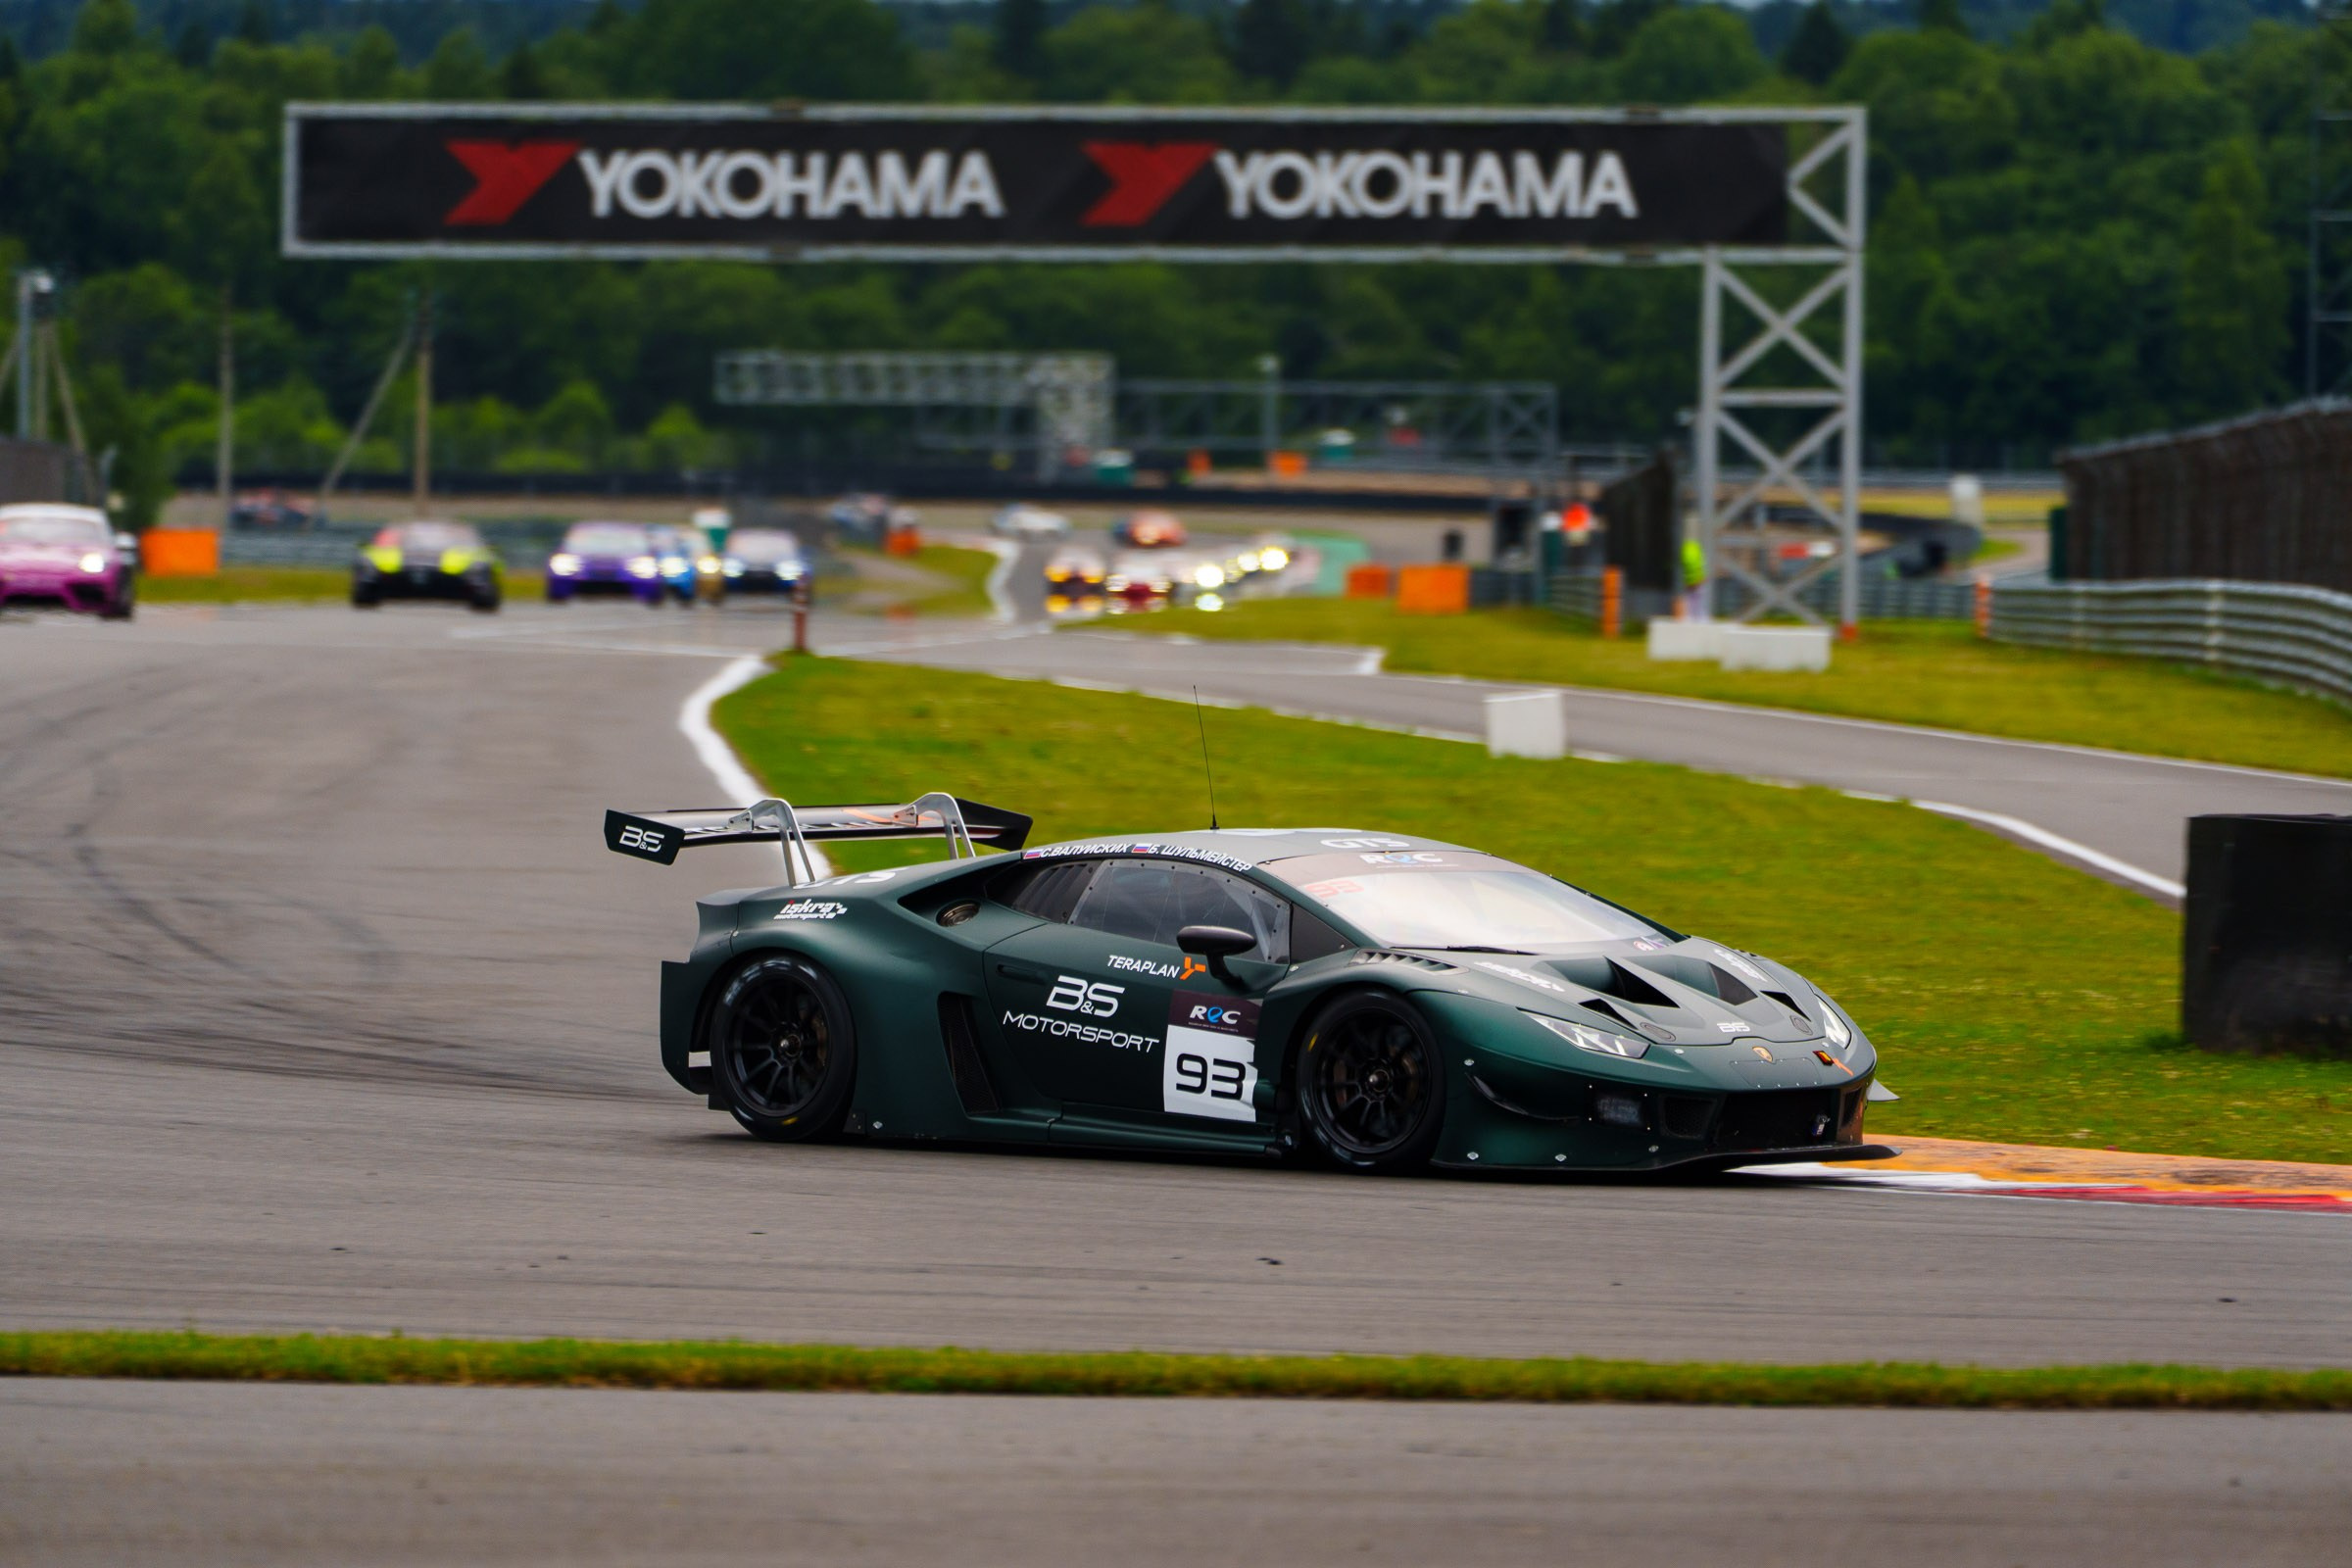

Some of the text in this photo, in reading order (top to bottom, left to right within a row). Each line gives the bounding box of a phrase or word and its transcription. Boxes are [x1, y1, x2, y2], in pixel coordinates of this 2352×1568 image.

[578, 149, 1004, 219] YOKOHAMA
[1214, 150, 1638, 220] YOKOHAMA
[1107, 955, 1180, 978] TERAPLAN
[1046, 975, 1125, 1017] B&S
[1003, 1010, 1159, 1053] MOTORSPORT
[1176, 1053, 1246, 1101] 93
